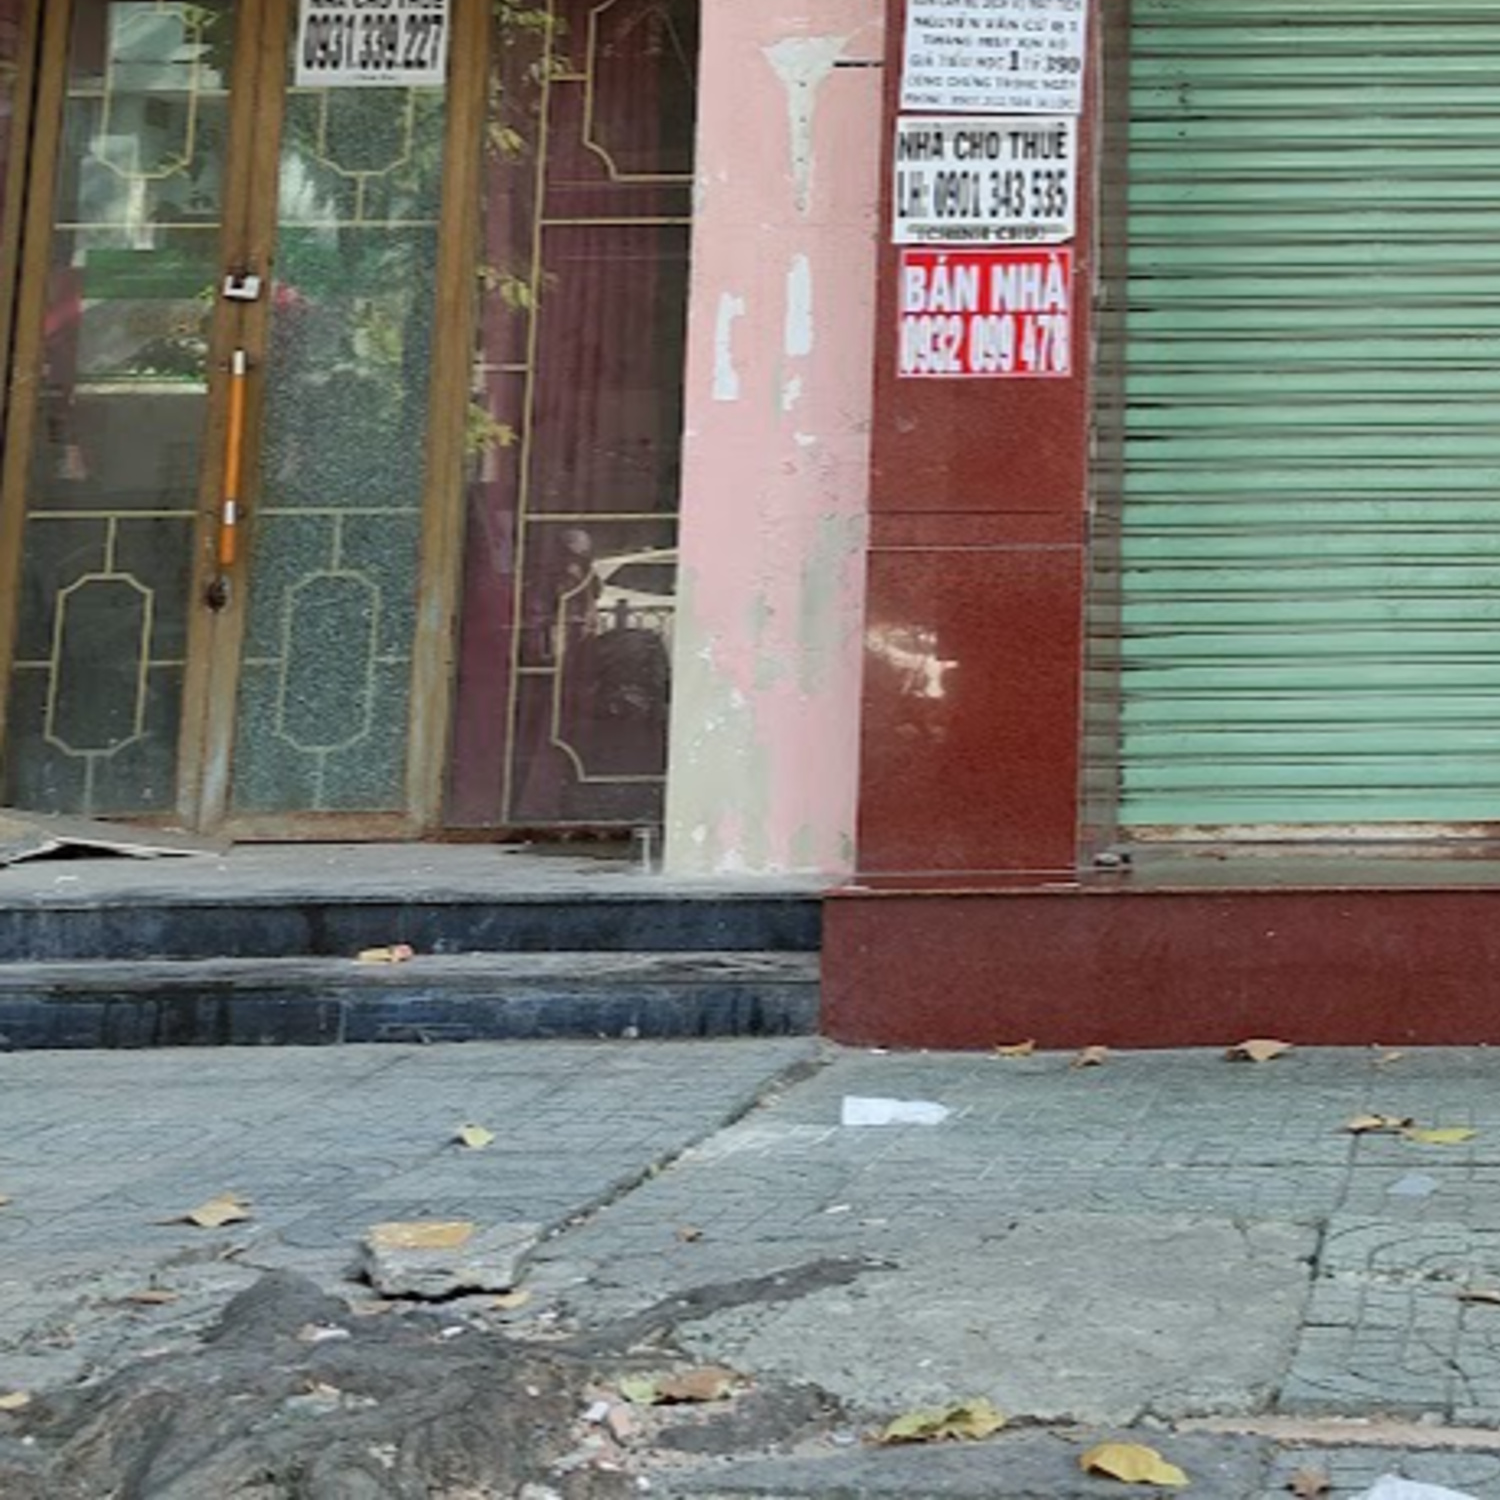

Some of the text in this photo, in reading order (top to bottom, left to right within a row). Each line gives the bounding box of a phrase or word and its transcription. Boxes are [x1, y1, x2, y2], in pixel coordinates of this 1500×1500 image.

[953, 130, 1001, 160] CHO
[1007, 122, 1069, 160] THUÊ
[904, 252, 1068, 313] BÁN NHÀ
